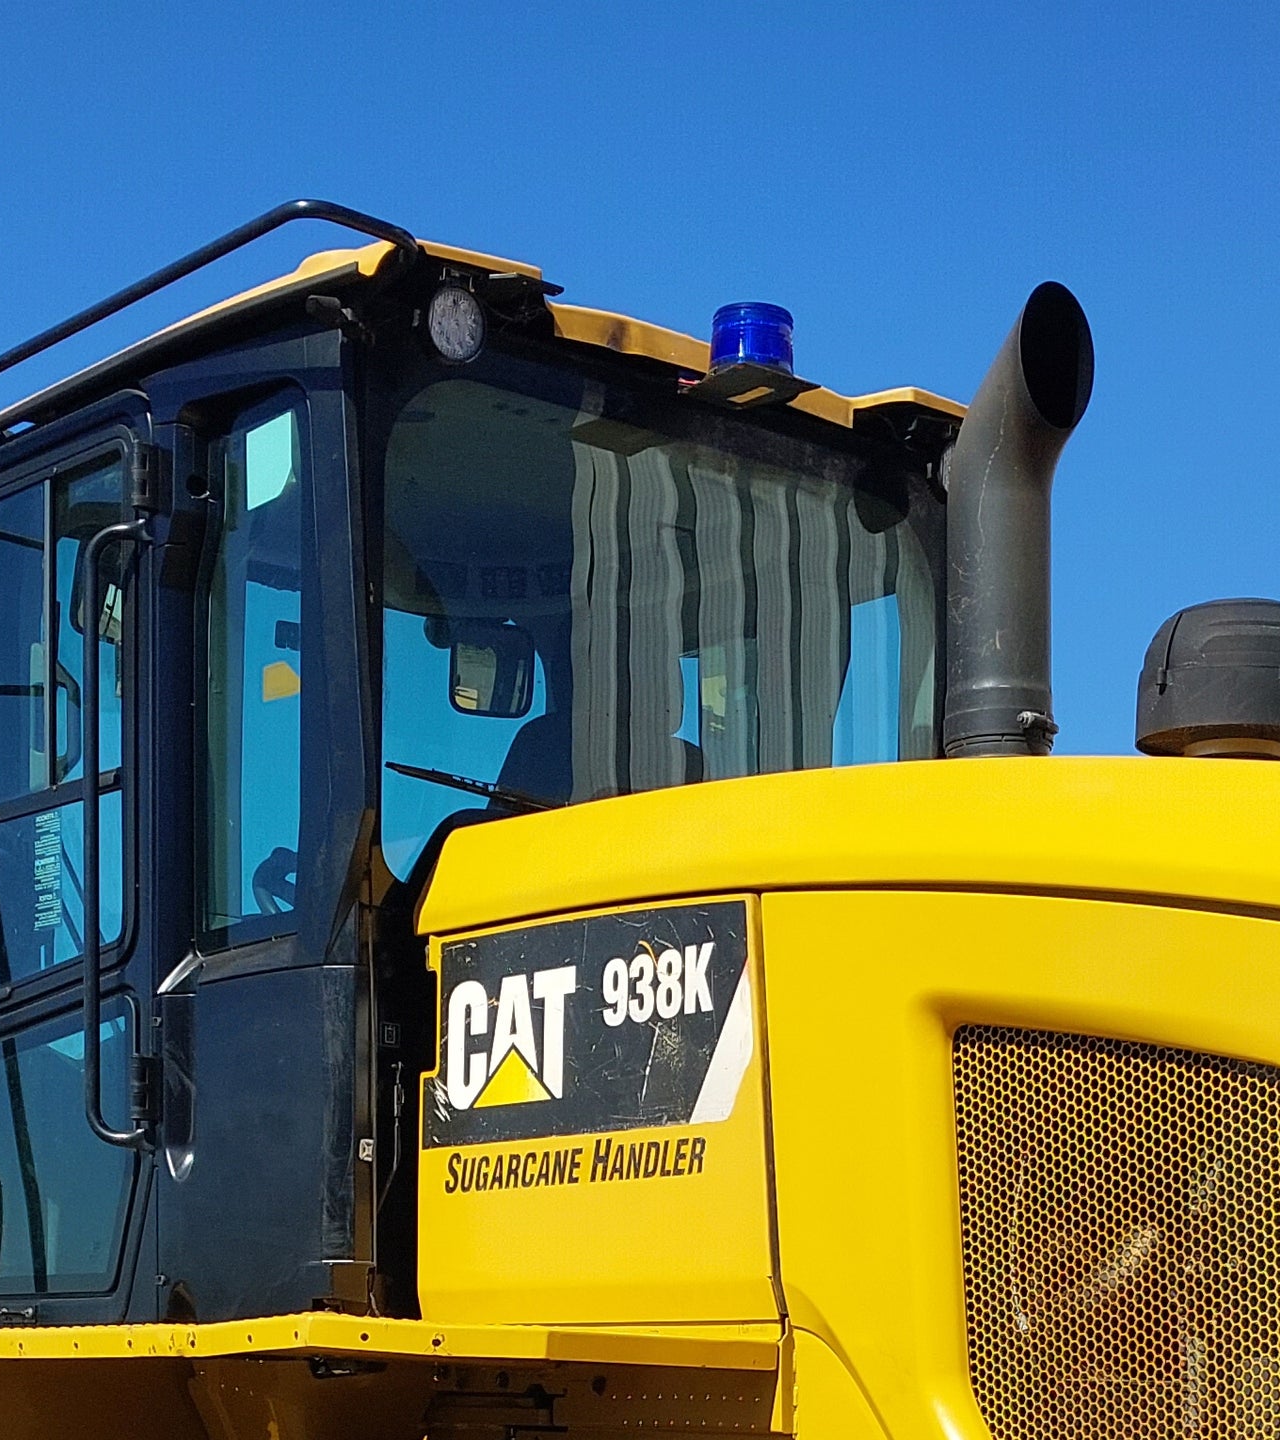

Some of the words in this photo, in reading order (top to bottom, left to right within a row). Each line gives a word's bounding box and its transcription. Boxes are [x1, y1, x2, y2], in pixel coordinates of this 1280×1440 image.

[446, 965, 577, 1111] CAT
[601, 942, 715, 1027] 938K
[444, 1148, 584, 1194] SUGARCANE
[589, 1137, 707, 1183] HANDLER
